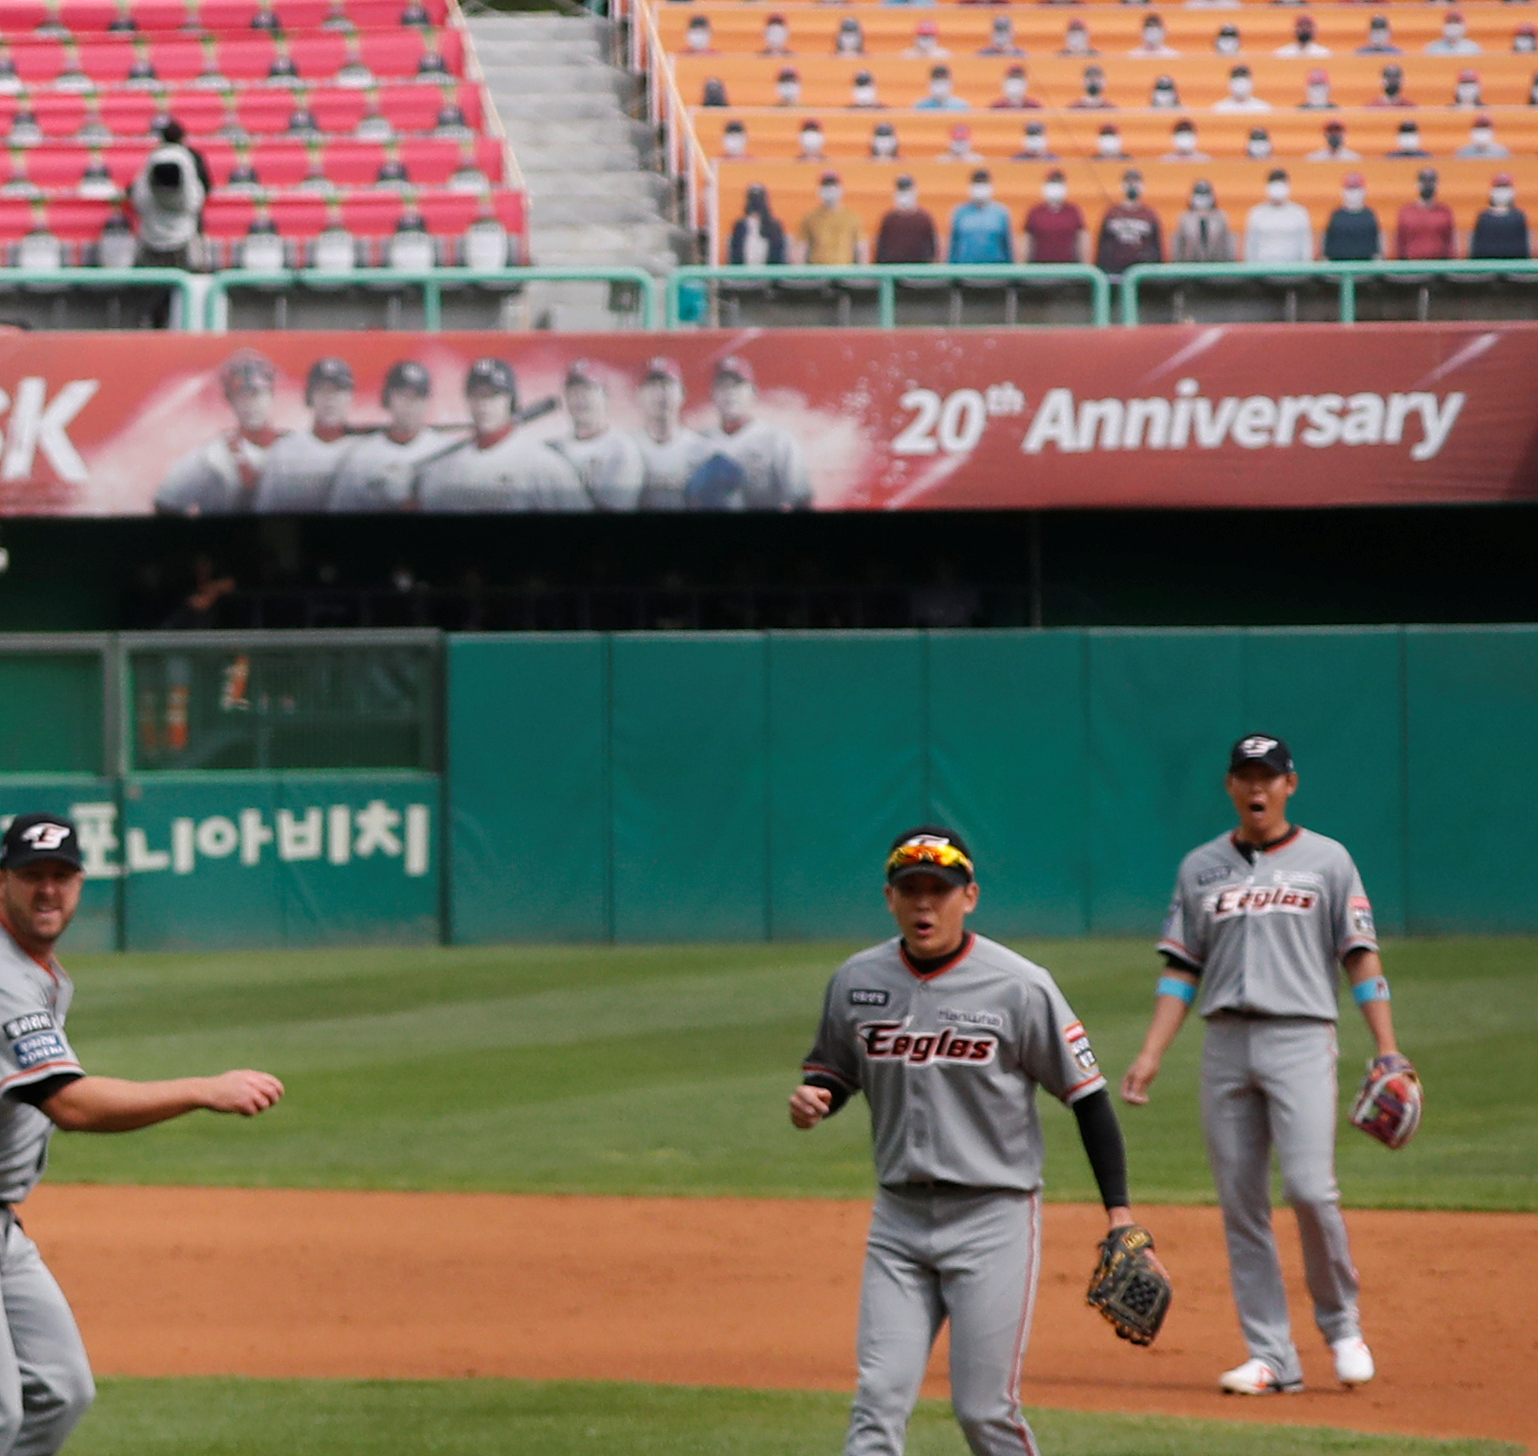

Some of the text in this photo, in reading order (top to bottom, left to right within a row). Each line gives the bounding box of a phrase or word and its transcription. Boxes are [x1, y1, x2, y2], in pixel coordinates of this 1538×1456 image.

[891, 378, 1465, 462] 20th Anniversary
[857, 1015, 997, 1065] Eagles
